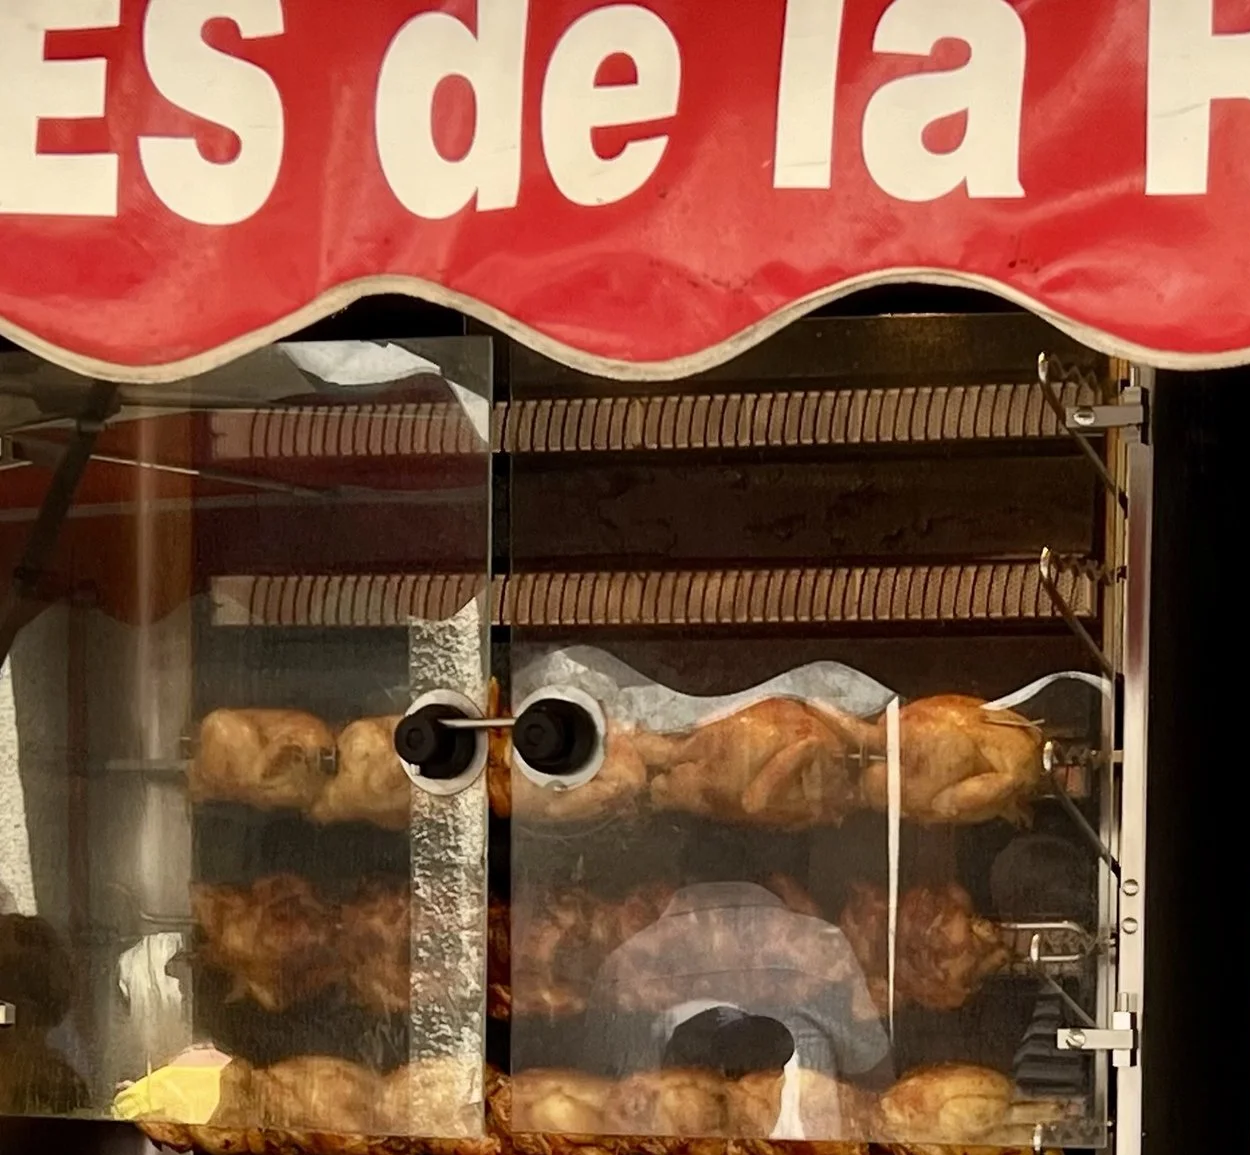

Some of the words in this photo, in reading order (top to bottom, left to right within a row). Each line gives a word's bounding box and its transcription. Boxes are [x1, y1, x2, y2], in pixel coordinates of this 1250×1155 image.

[0, 0, 285, 225] ES
[375, 0, 682, 219] de
[773, 0, 1026, 202] la
